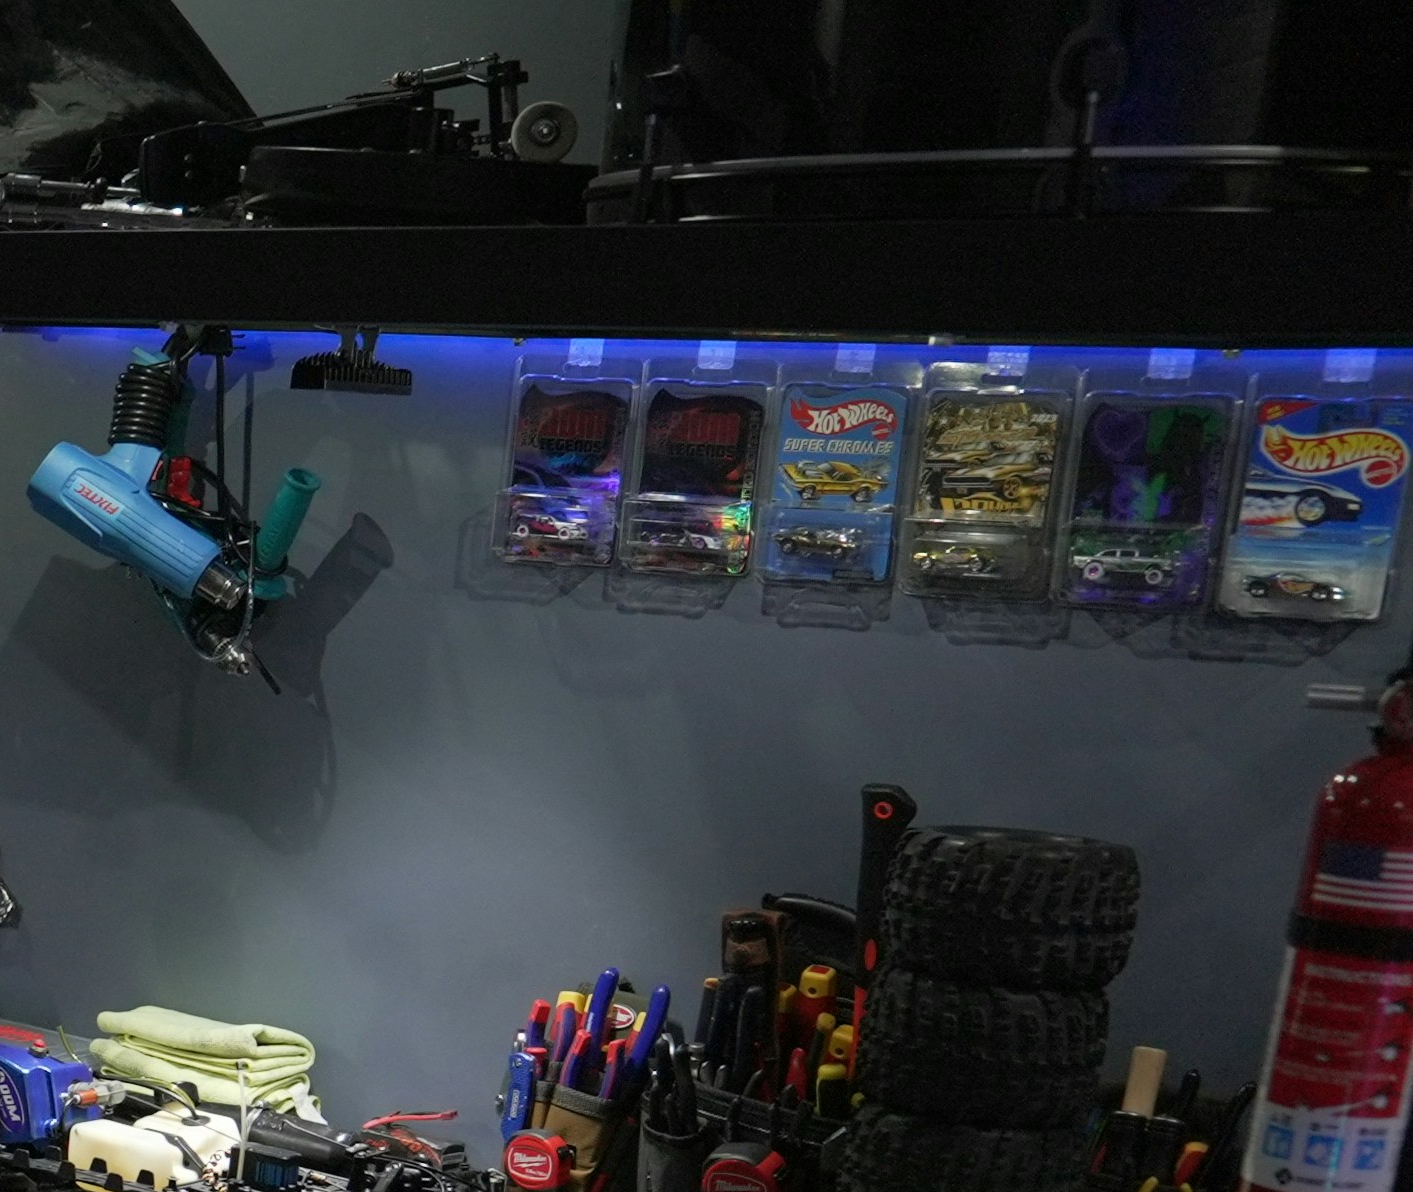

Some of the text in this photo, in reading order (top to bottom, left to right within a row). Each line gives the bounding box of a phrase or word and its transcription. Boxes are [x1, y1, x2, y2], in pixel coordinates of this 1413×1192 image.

[783, 437, 895, 455] SUPER CHROMES
[74, 483, 119, 517] FIXTEC
